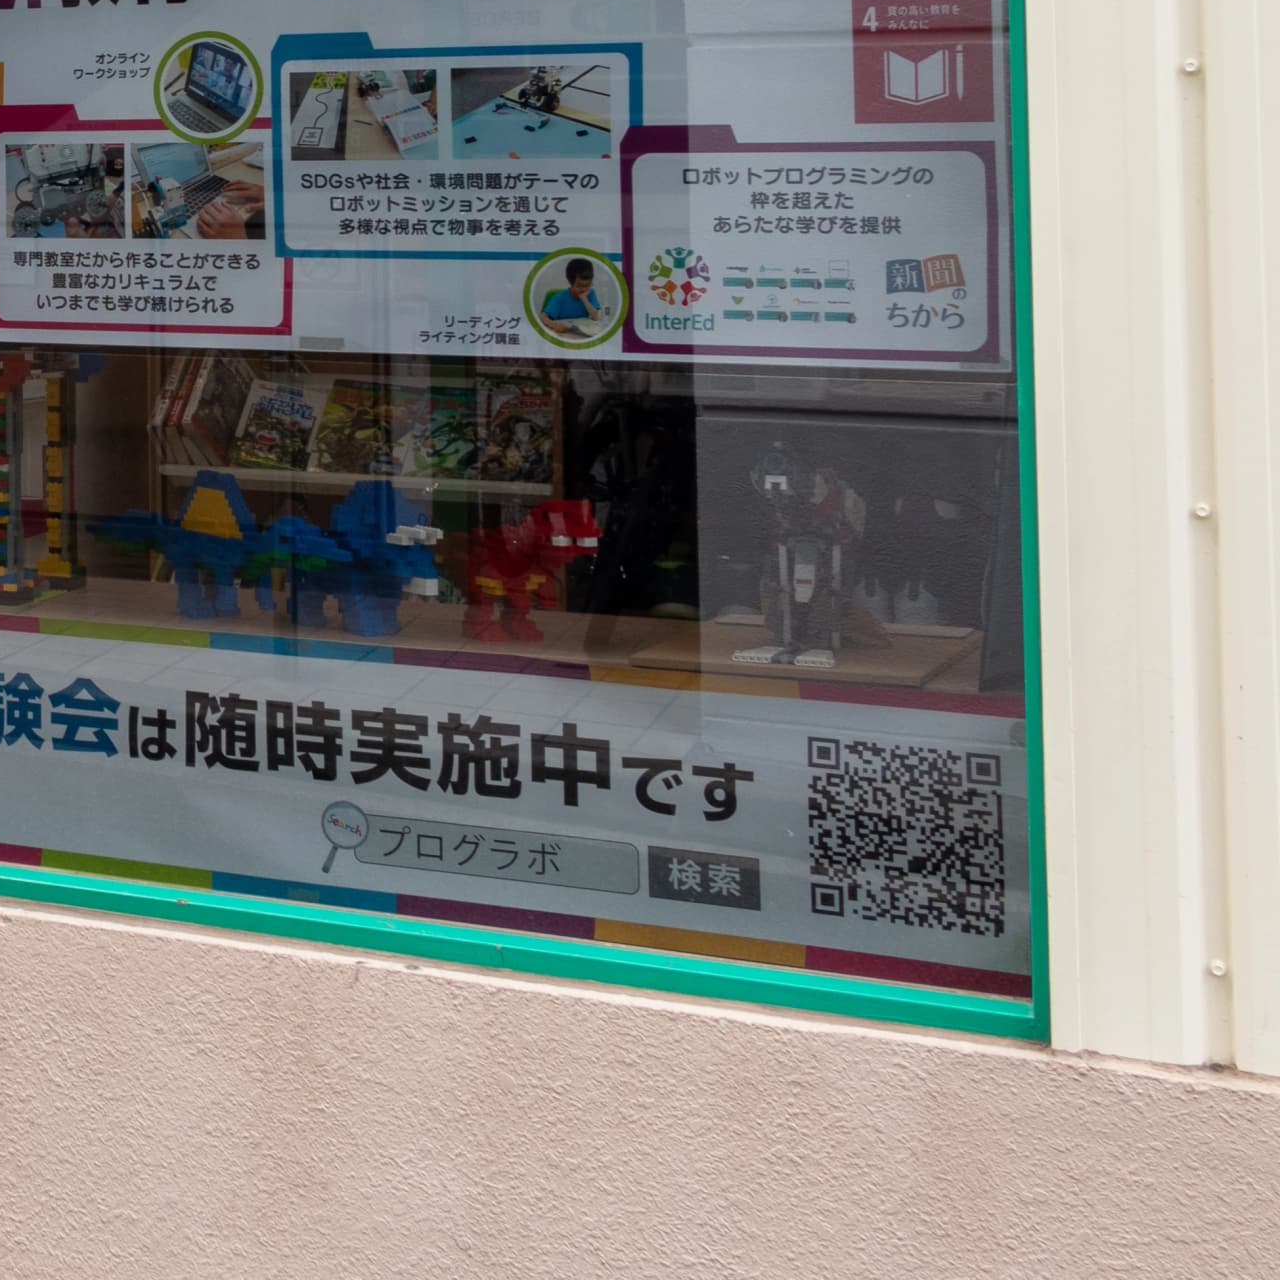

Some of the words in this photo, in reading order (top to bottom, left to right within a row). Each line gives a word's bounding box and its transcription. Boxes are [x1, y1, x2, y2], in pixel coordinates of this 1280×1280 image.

[95, 52, 150, 66] オンライン
[73, 67, 150, 81] ワークショップ
[682, 165, 934, 187] ロボットプログラミングの
[329, 195, 569, 215] ロボットミッションを通じて
[750, 191, 855, 211] 枠を超えた
[338, 217, 561, 238] 多様な視点で物事を考える
[713, 214, 903, 236] あらたな学びを提供
[12, 250, 262, 271] 専門教室だから作ることができる
[51, 272, 218, 291] 豊富なカリキュラムで
[35, 293, 235, 314] いつまでも学び続けられる
[444, 316, 521, 330] リーディング
[645, 313, 715, 332] InterEd
[885, 302, 966, 329] ちから
[418, 331, 521, 346] ライティング講座
[378, 825, 562, 876] プログラボ
[668, 857, 742, 897] 検索
